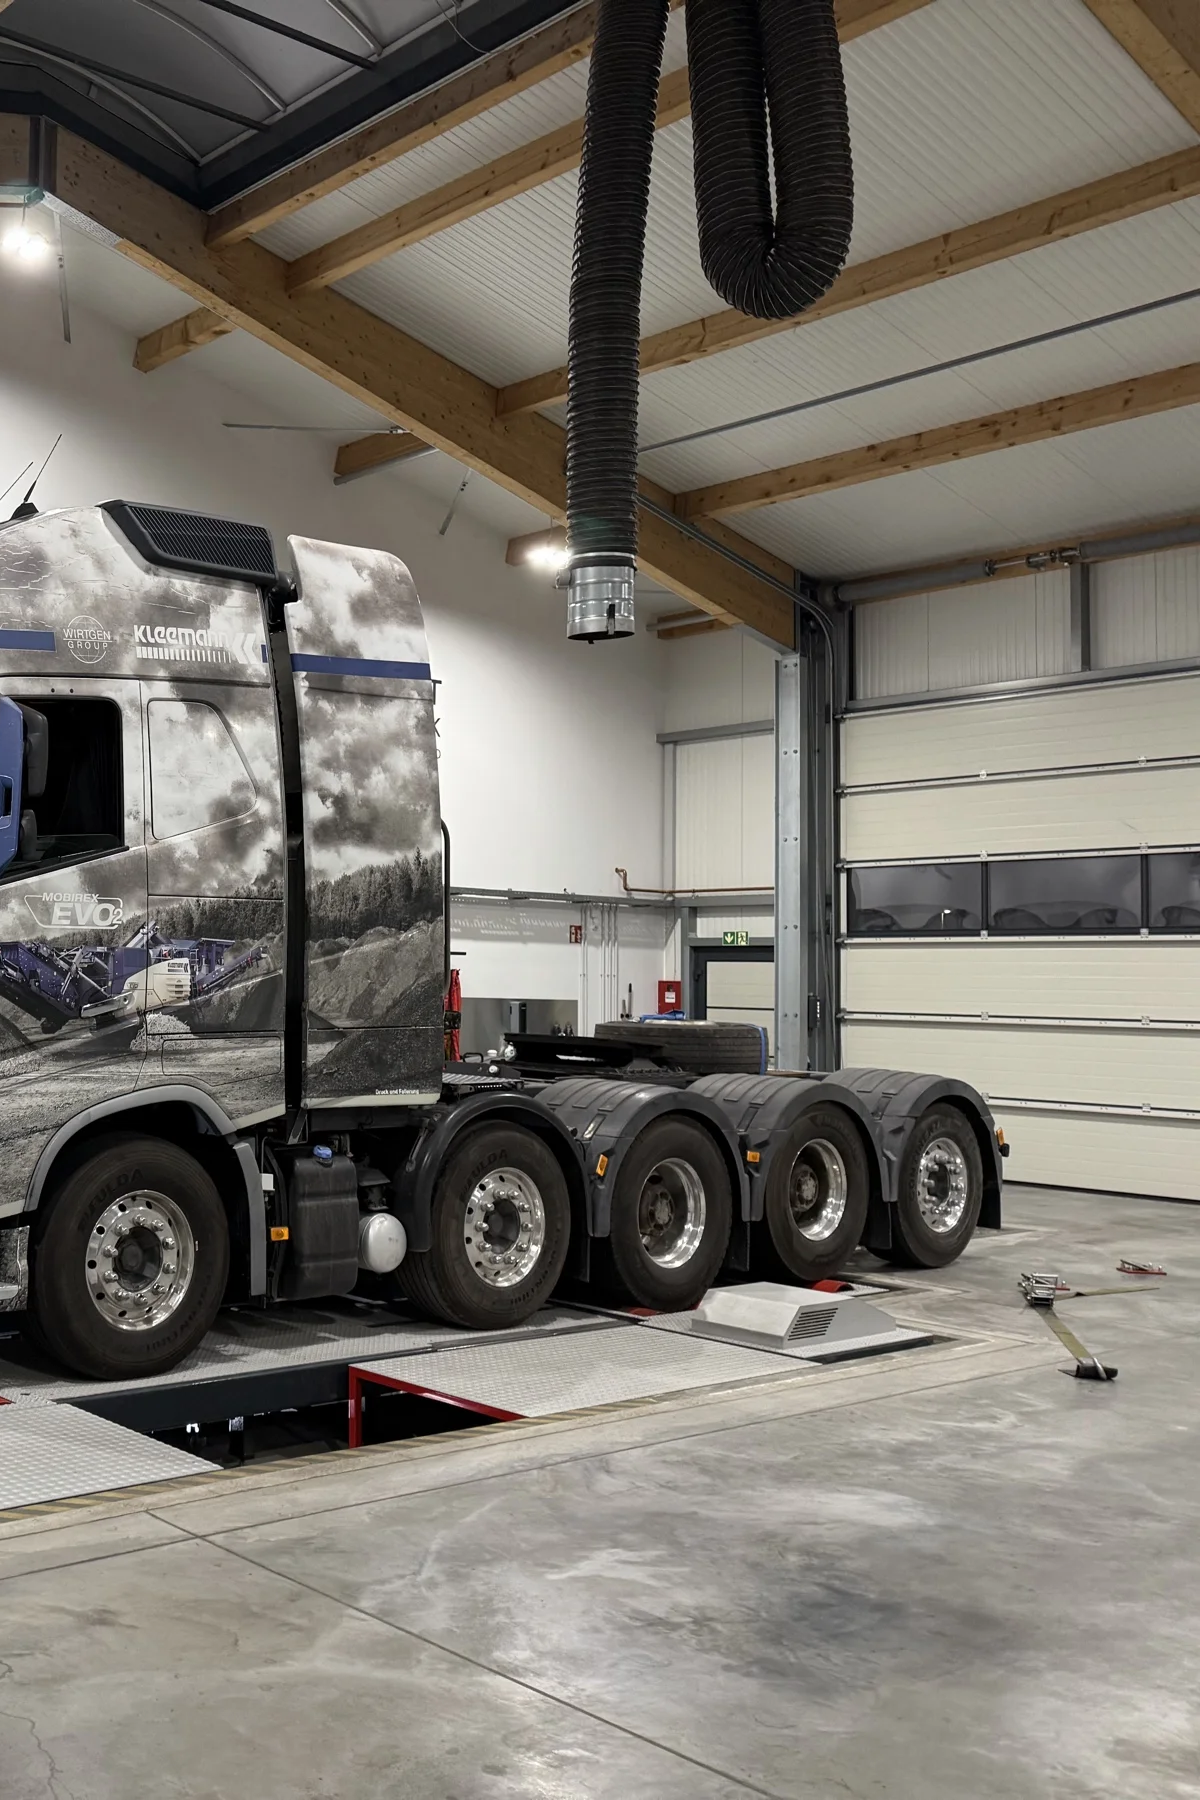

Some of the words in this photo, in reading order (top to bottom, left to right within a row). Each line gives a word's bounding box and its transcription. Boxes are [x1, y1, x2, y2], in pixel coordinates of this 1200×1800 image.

[63, 628, 112, 640] WIRTGEN
[67, 641, 108, 649] GROUP
[42, 892, 100, 903] MOBIREX
